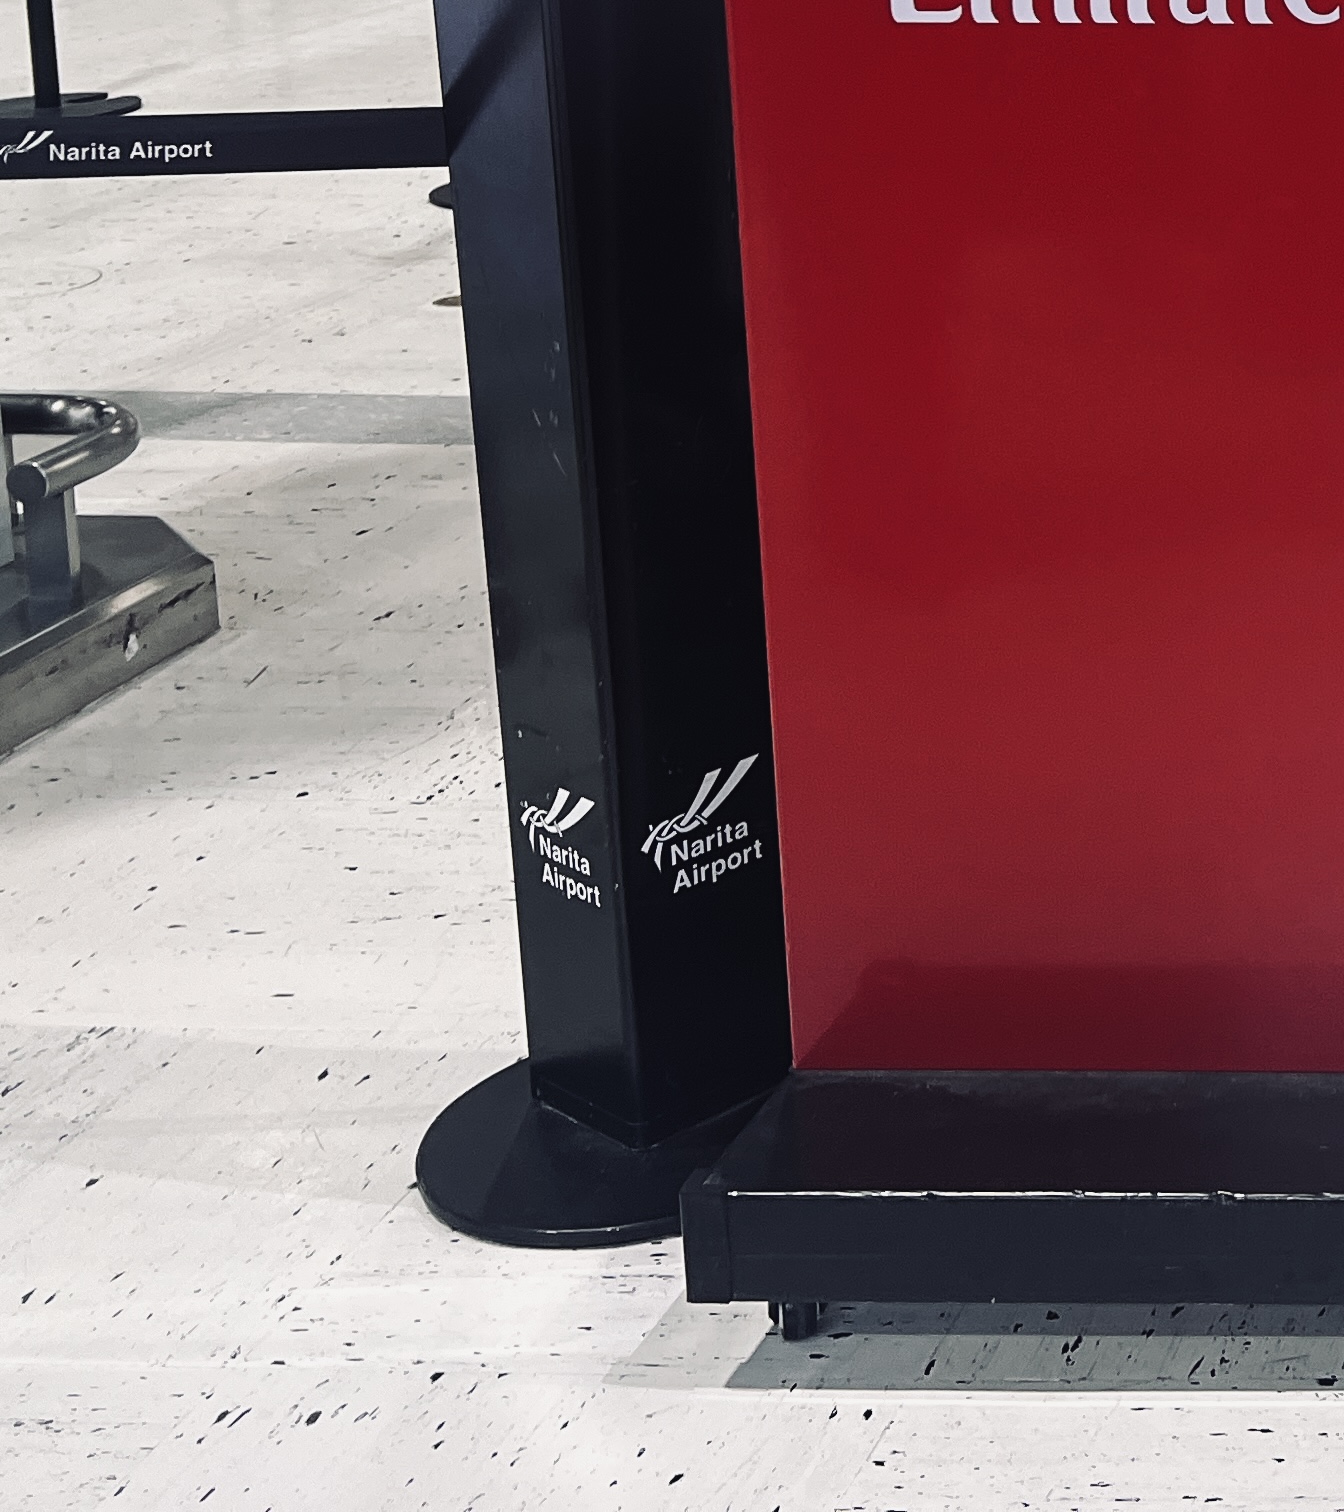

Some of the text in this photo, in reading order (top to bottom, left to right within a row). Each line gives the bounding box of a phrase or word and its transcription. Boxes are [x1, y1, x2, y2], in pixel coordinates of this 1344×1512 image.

[49, 139, 214, 163] Narita Airport
[539, 834, 591, 876] Narita
[670, 821, 749, 866] Narita
[542, 861, 601, 908] Airport
[673, 839, 763, 894] Airport
